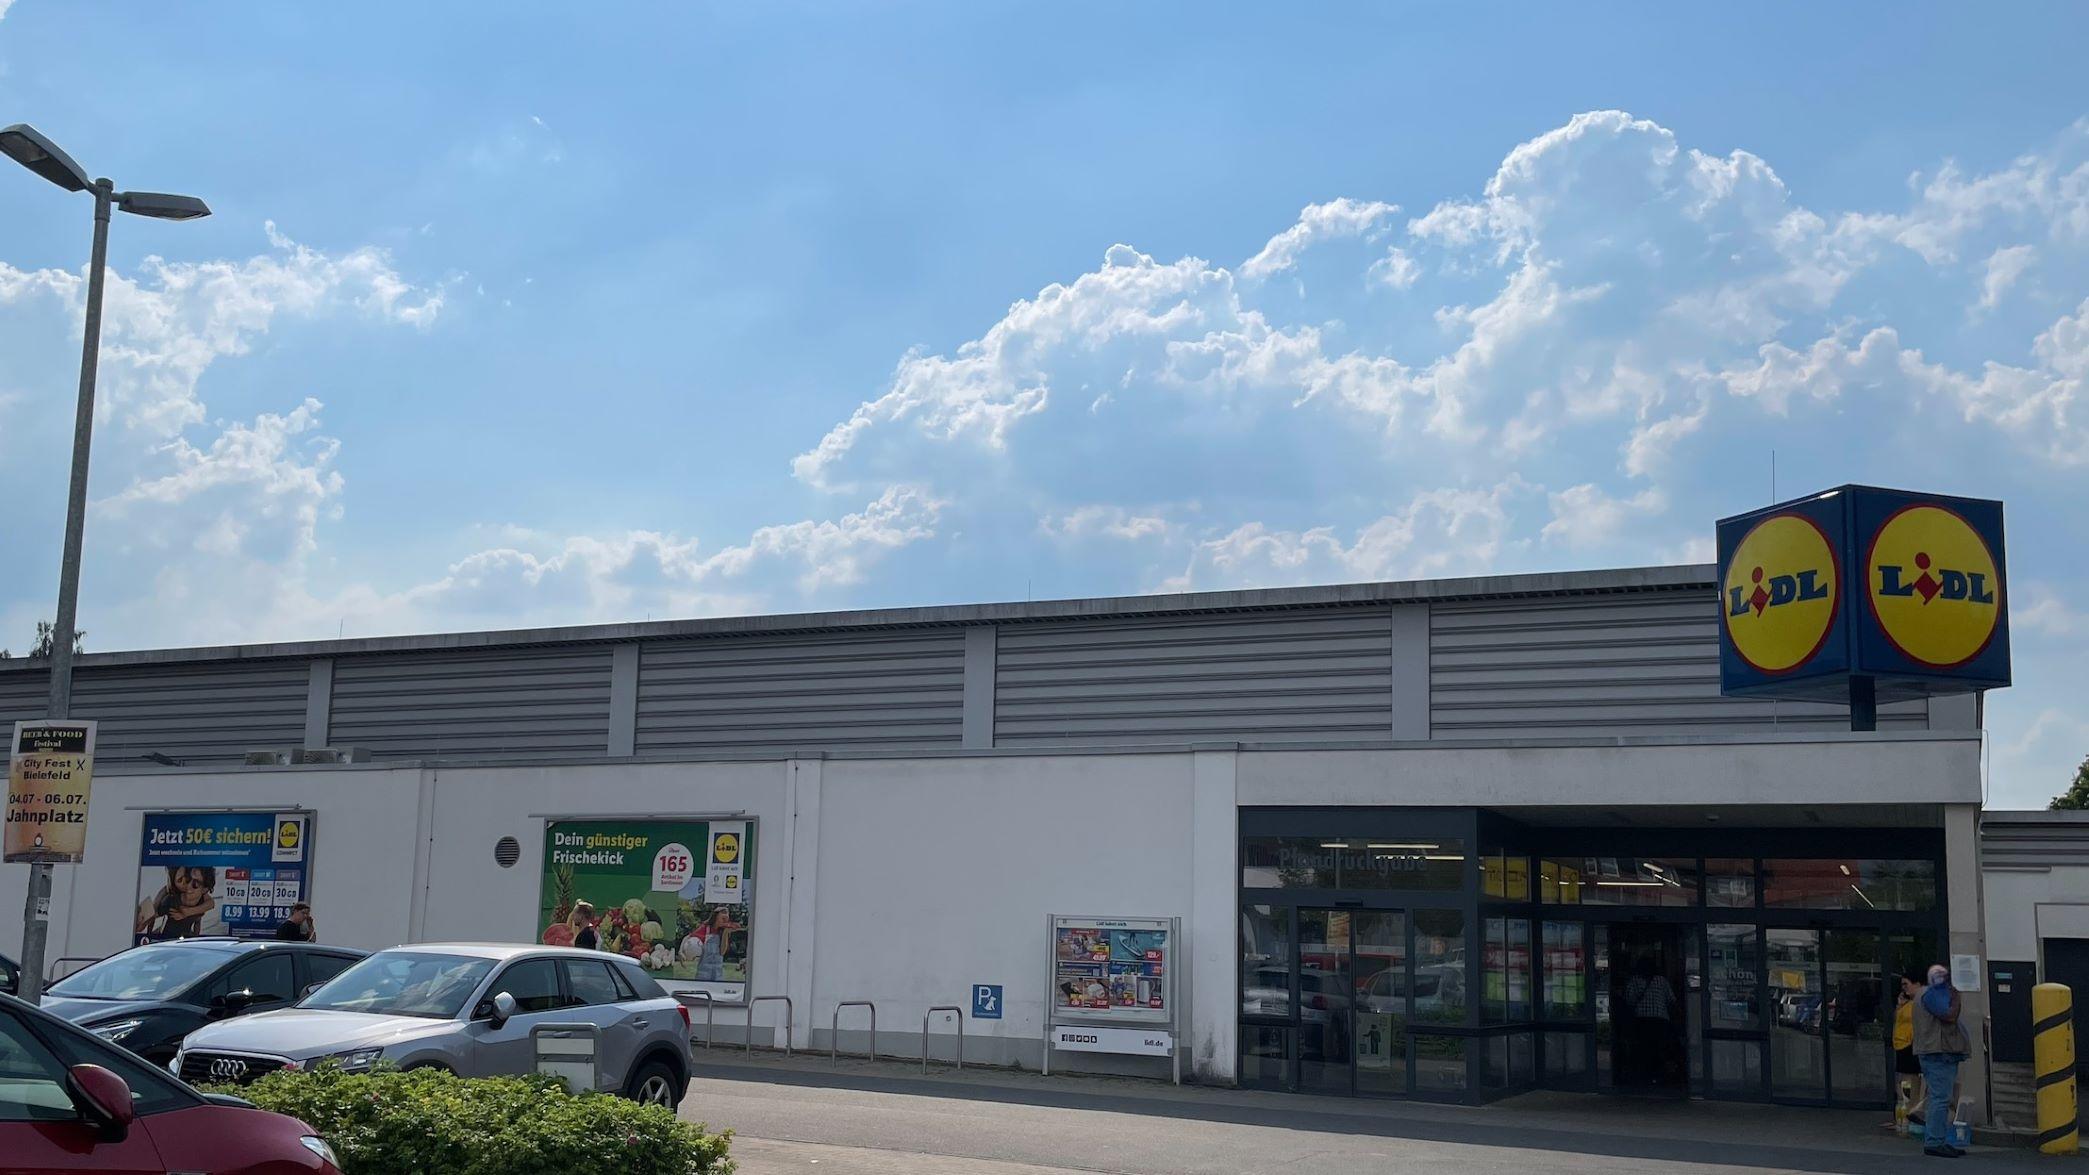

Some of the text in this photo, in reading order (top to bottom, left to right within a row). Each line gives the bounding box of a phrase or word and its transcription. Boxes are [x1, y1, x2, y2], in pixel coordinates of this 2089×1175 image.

[52, 730, 84, 739] FOOD
[24, 759, 42, 769] City
[45, 759, 71, 768] Fest
[24, 771, 71, 780] Bielefeld
[9, 794, 35, 804] 04.07
[45, 794, 87, 804] 06.07.
[7, 809, 84, 826] Jahnplatz
[150, 827, 272, 845] Jetzt 50€ sichern!
[554, 832, 649, 850] Dein günstiger
[553, 850, 624, 865] Frischekick
[660, 855, 687, 872] 165
[226, 887, 235, 896] 10
[251, 888, 260, 897] 20
[276, 888, 286, 897] 30
[225, 906, 243, 917] 8.99
[249, 907, 270, 918] 13.99
[274, 907, 291, 919] 18.9
[978, 986, 992, 1005] P
